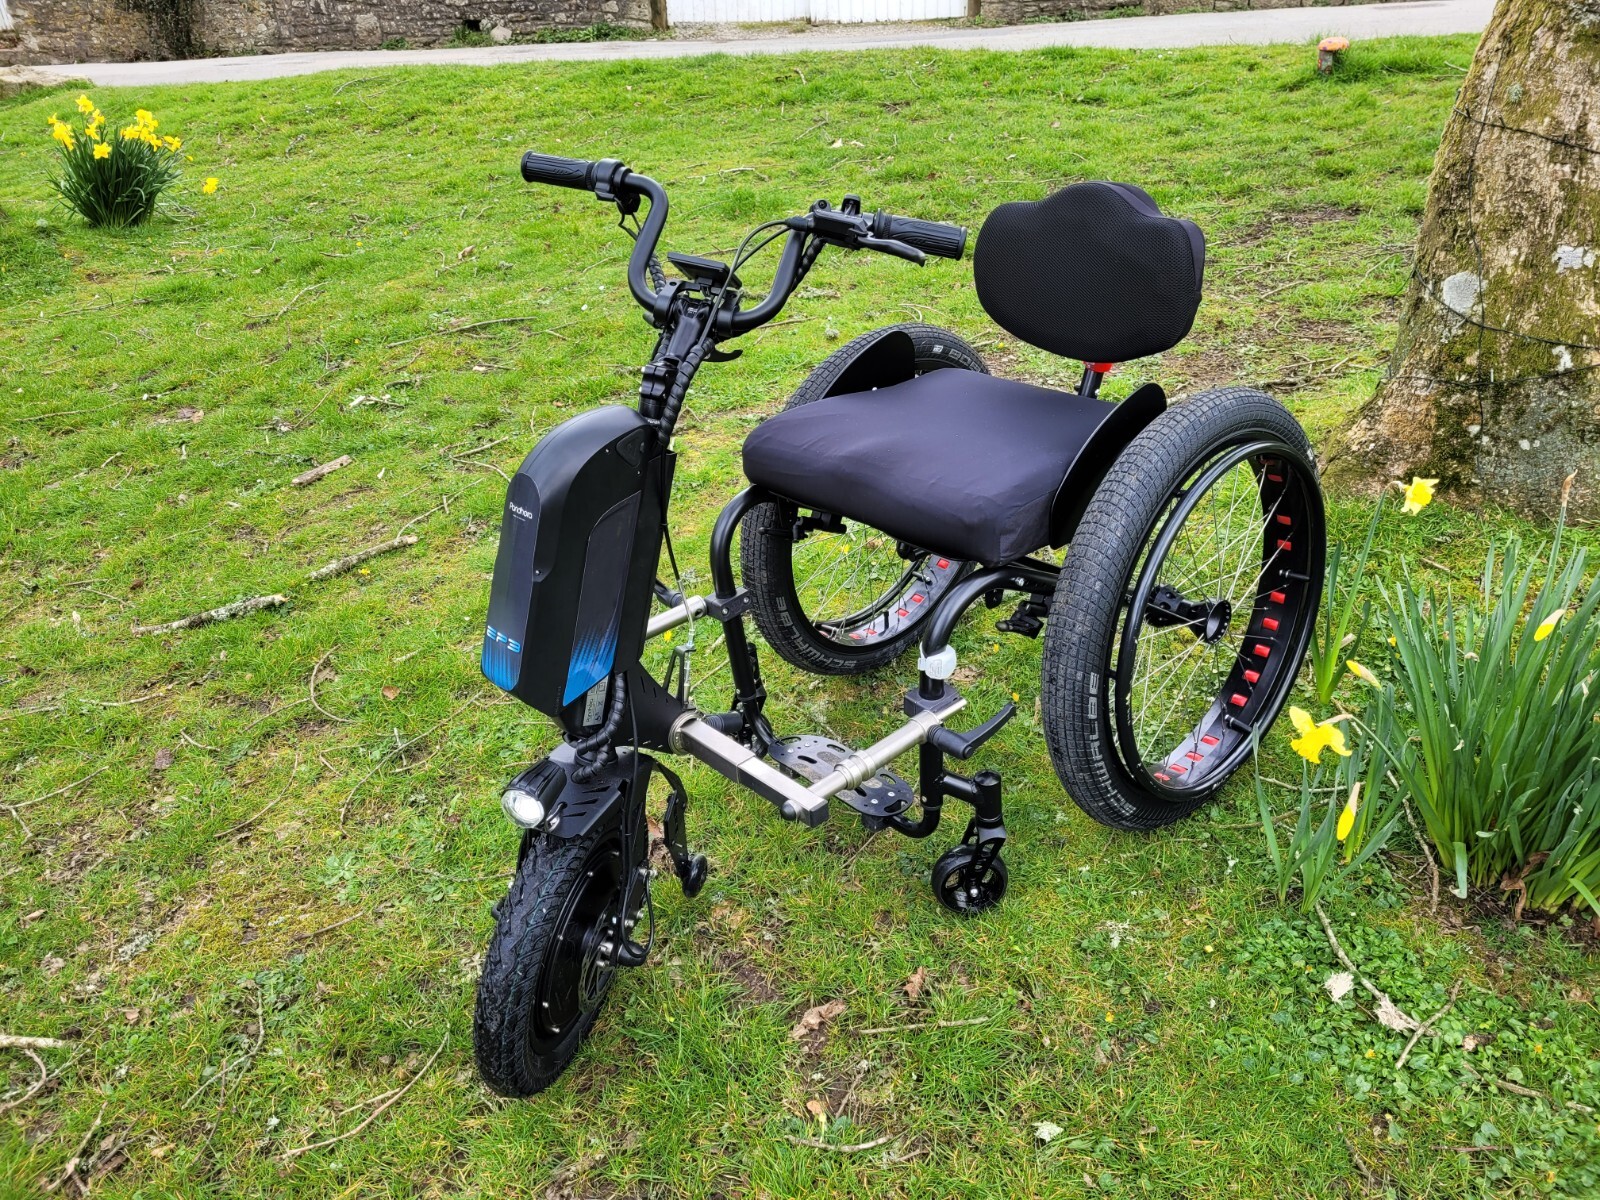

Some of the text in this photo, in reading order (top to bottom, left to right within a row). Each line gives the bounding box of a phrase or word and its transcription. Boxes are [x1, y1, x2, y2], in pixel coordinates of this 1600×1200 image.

[486, 625, 521, 653] EP3
[776, 596, 857, 669] SCHWALBE
[1088, 672, 1137, 817] SCHWALBE
